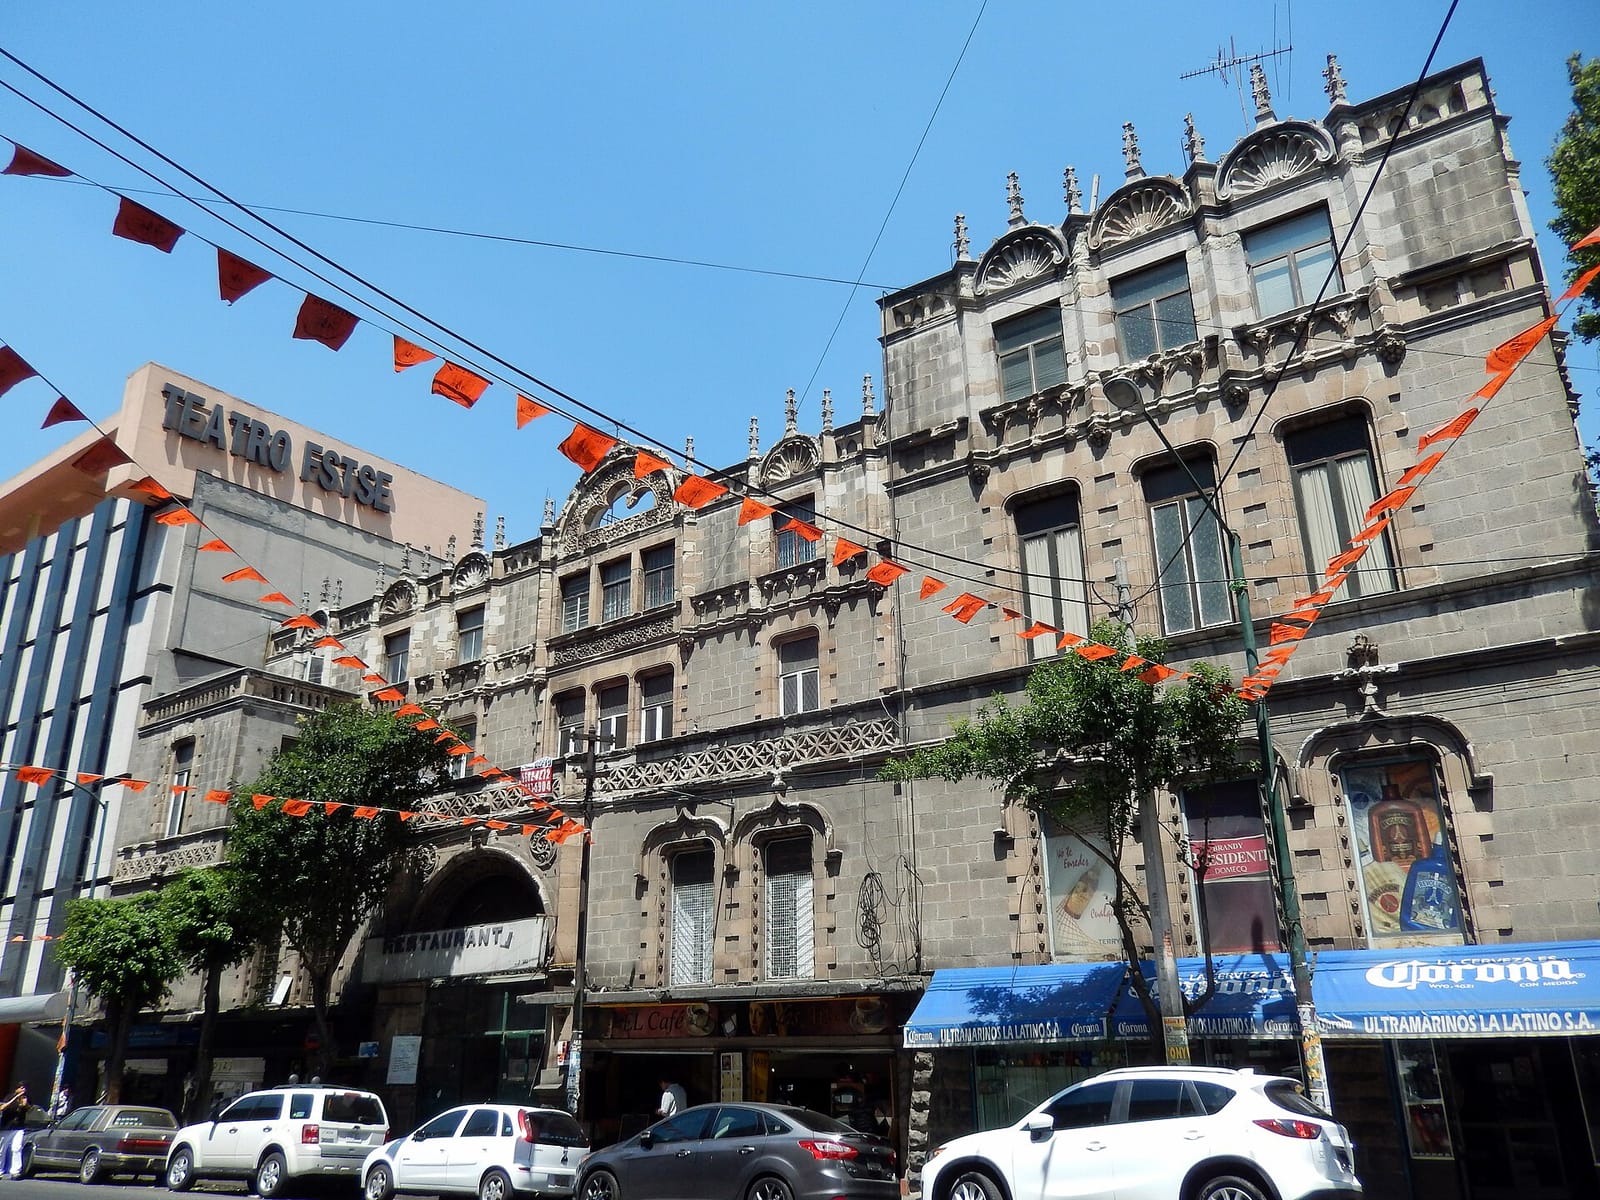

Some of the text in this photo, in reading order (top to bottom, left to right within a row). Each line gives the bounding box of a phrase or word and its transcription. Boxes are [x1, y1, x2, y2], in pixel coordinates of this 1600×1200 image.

[162, 382, 393, 513] TEATRO FSTSE
[1212, 842, 1243, 852] BRANDY
[1214, 865, 1248, 875] DOMECQ
[1365, 959, 1578, 991] Corona
[648, 1009, 685, 1032] Café
[1118, 1021, 1148, 1035] Corona
[1208, 1017, 1221, 1034] LA
[1220, 1017, 1244, 1034] LATINO
[1263, 1019, 1299, 1034] Corona
[1363, 1014, 1477, 1034] ULTRAMARINOS
[1479, 1015, 1502, 1033] LA
[1503, 1013, 1562, 1032] LATINO
[1564, 1012, 1595, 1030] S.A.
[908, 1030, 933, 1043] Corona
[941, 1025, 1001, 1042] ULTRAMARINOS
[1002, 1024, 1014, 1040] LA
[1014, 1022, 1045, 1039] LATINO
[1071, 1022, 1100, 1037] Corona
